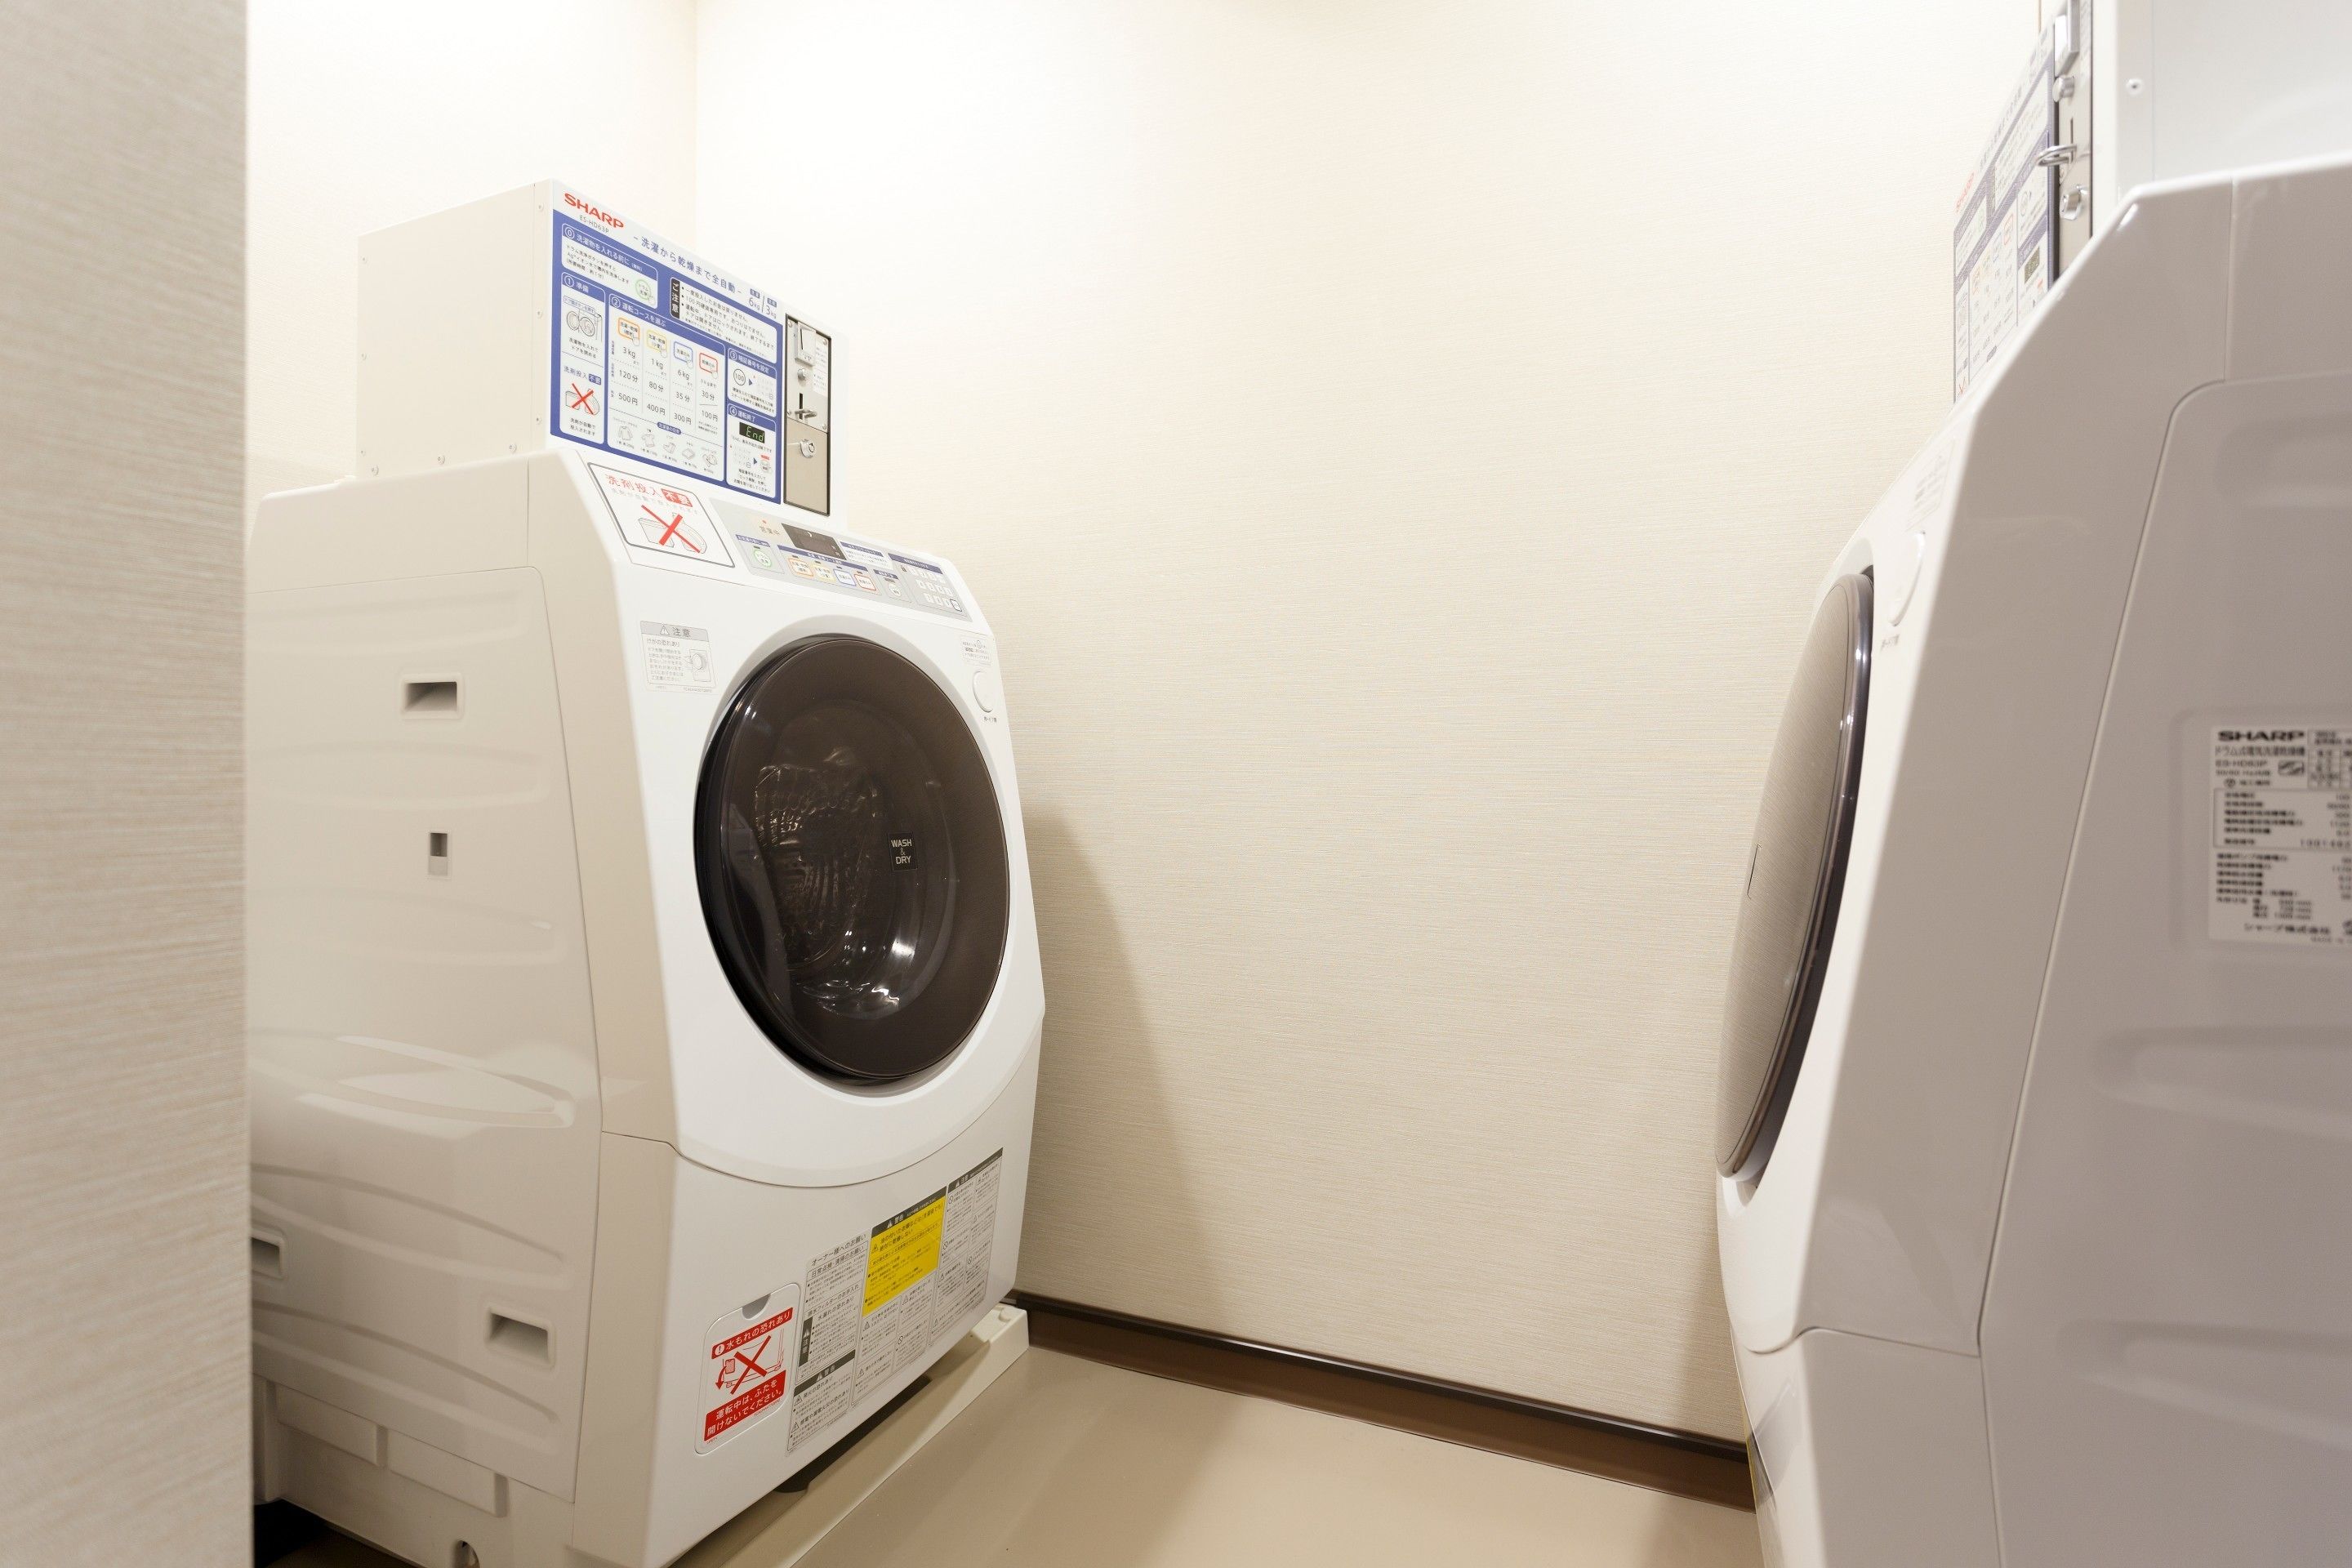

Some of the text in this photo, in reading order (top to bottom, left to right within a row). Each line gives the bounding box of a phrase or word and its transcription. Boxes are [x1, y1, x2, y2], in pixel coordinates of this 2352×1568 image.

[564, 193, 624, 229] SHARP
[623, 346, 635, 359] 3kg
[652, 358, 663, 369] 1kg
[619, 369, 637, 382] 120分
[677, 368, 689, 381] 6kg
[648, 381, 663, 392] 80分
[618, 393, 637, 406] 500円
[676, 391, 689, 402] 35分
[702, 390, 715, 400] 30分
[647, 403, 665, 416] 400円
[702, 410, 718, 421] 100円
[674, 412, 691, 425] 300円
[746, 425, 763, 441] End
[2218, 731, 2304, 741] SHARP
[891, 839, 912, 848] WASH
[900, 848, 906, 856] &
[895, 856, 911, 864] DRY
[726, 1312, 790, 1349] 水もれの恐れあり
[715, 1380, 777, 1420] 運転中は、ふたを
[707, 1390, 782, 1437] 開けないでください。
